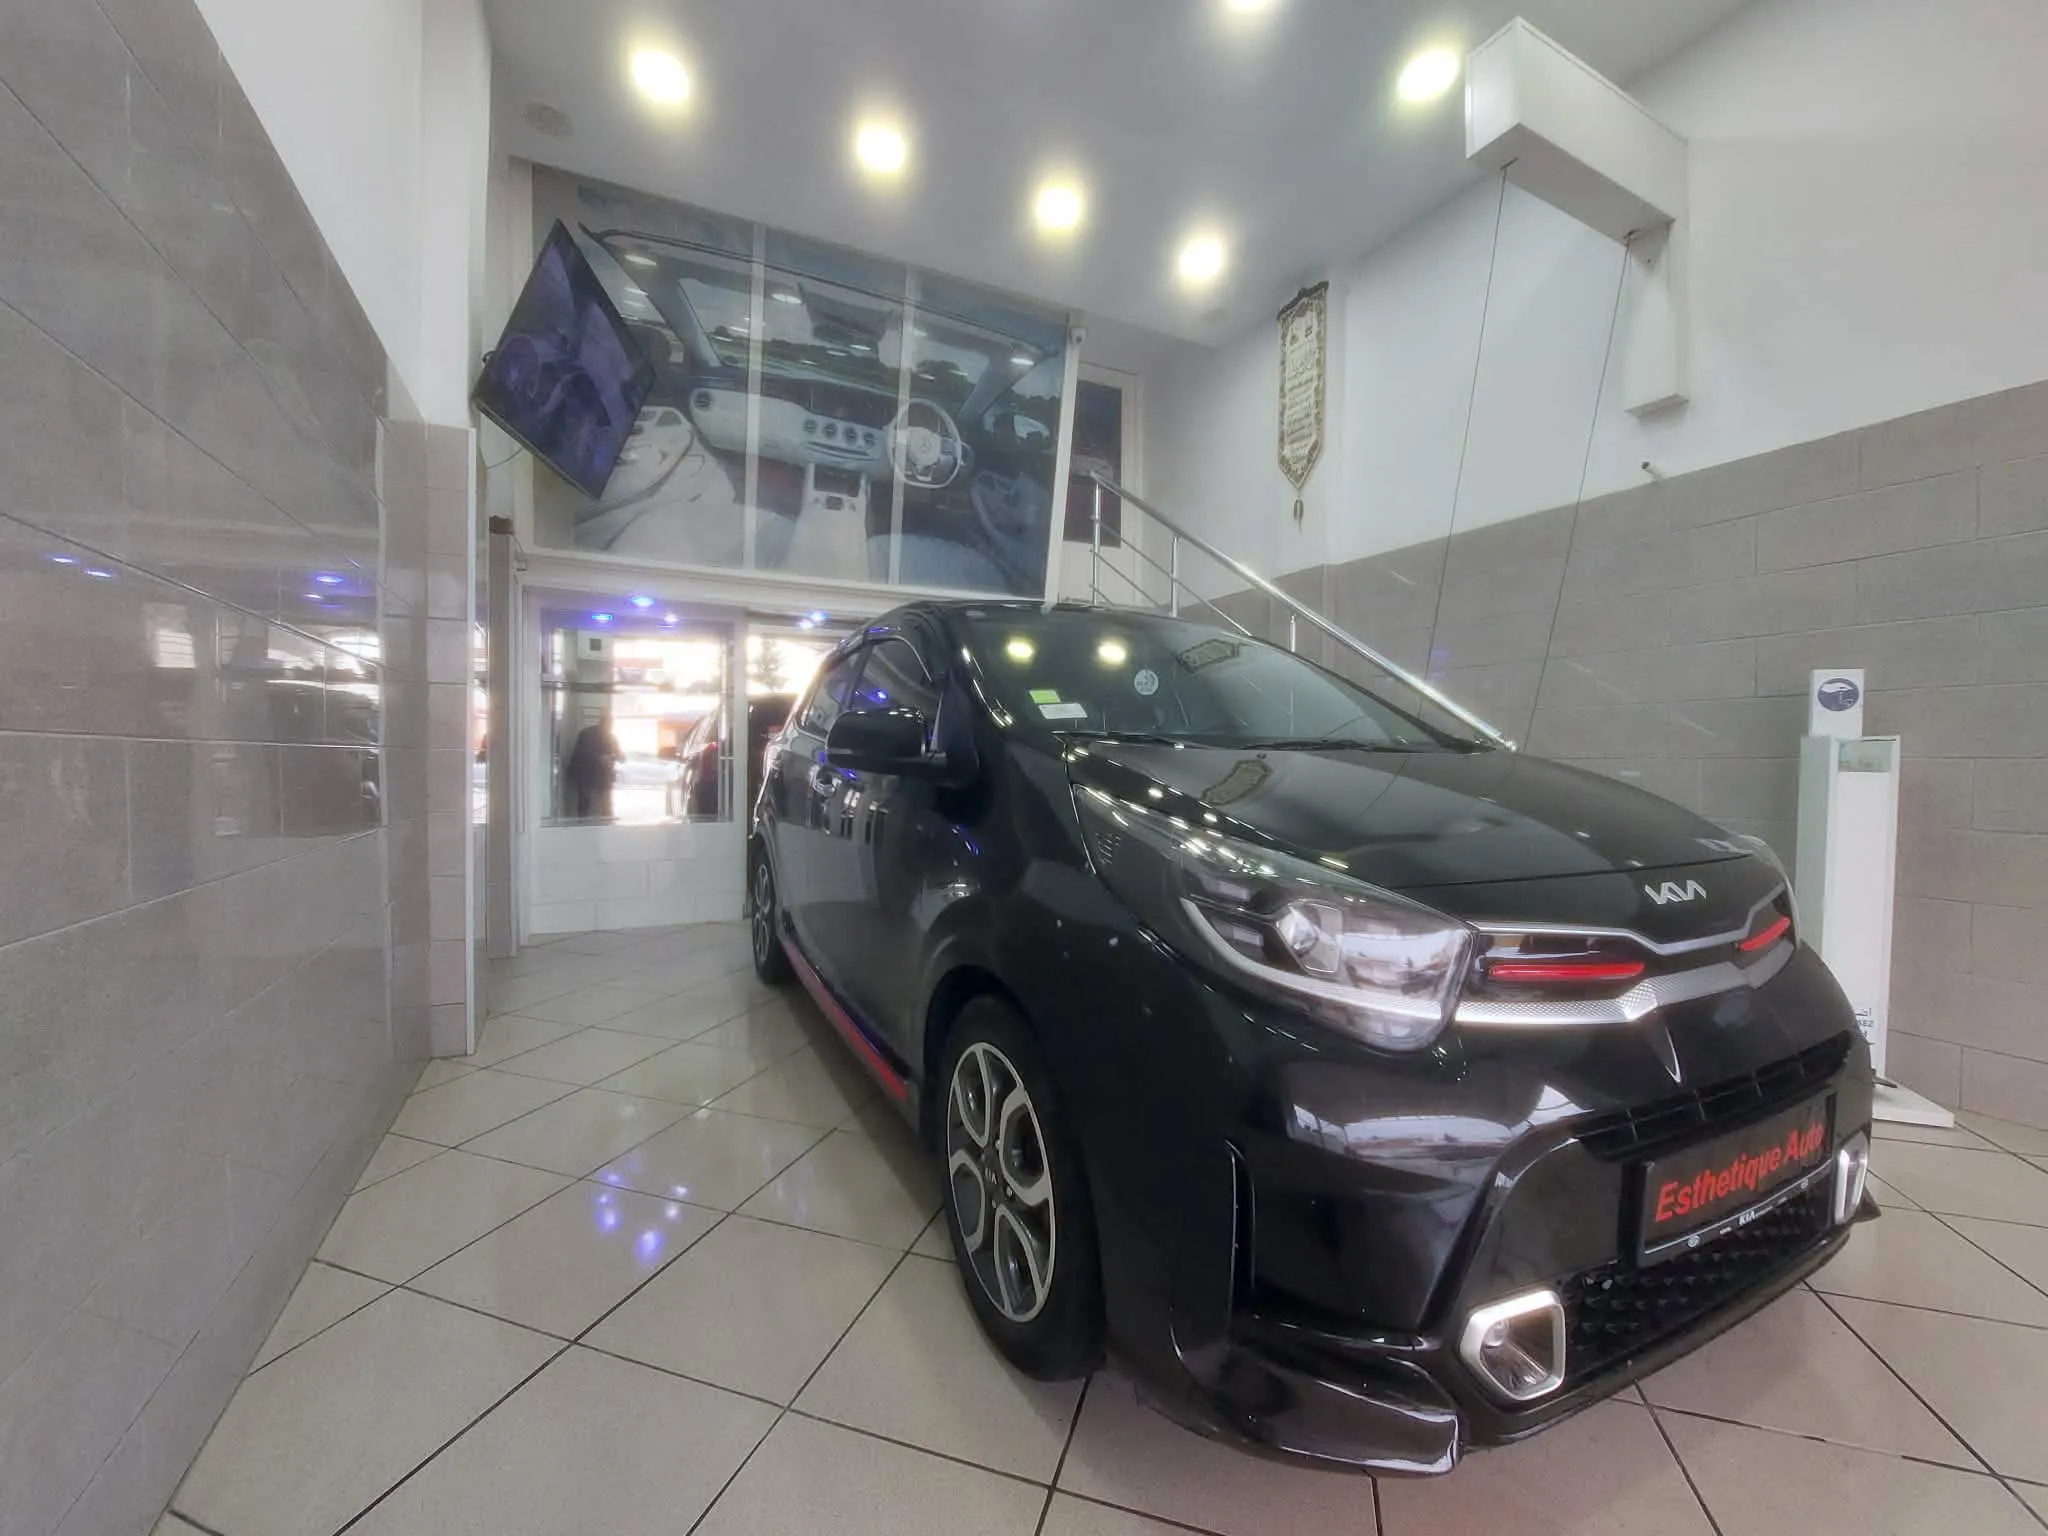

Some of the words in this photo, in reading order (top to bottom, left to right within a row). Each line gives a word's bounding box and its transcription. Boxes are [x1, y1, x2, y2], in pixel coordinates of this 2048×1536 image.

[1656, 1149, 1782, 1222] Esthetique
[1783, 1122, 1825, 1164] Auto
[1739, 1209, 1757, 1226] KIA
